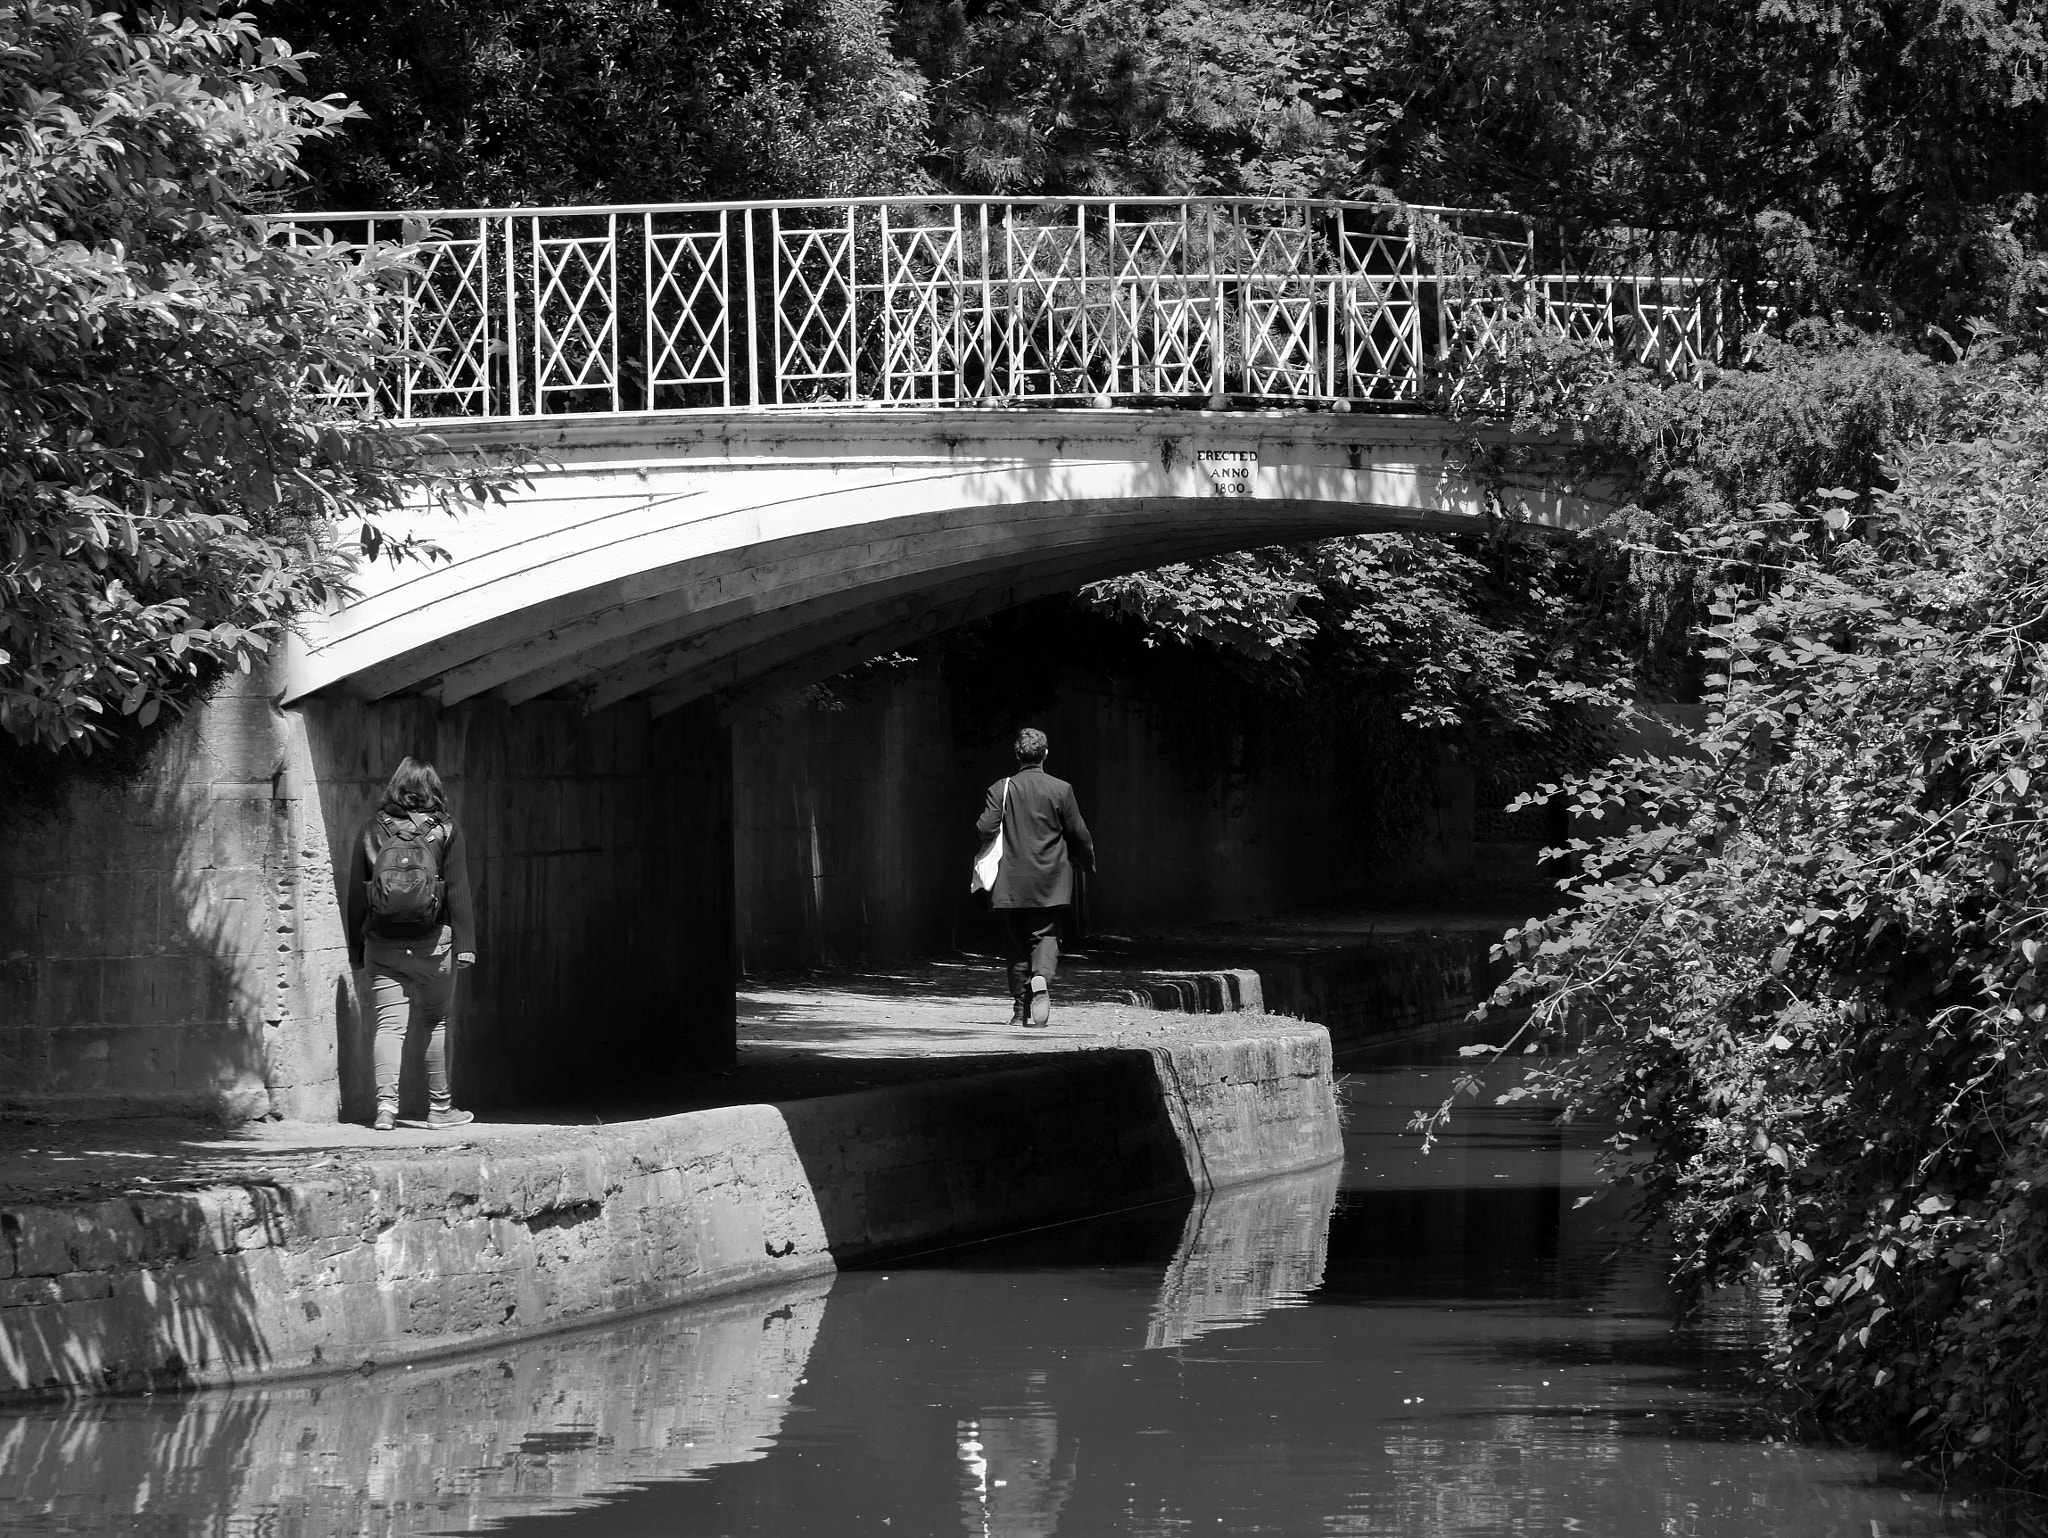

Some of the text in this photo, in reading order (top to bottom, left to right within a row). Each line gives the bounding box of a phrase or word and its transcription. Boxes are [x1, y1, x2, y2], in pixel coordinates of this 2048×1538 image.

[1197, 450, 1258, 461] ERECTED
[1210, 468, 1249, 478] ANNO
[1214, 483, 1245, 493] 1800
